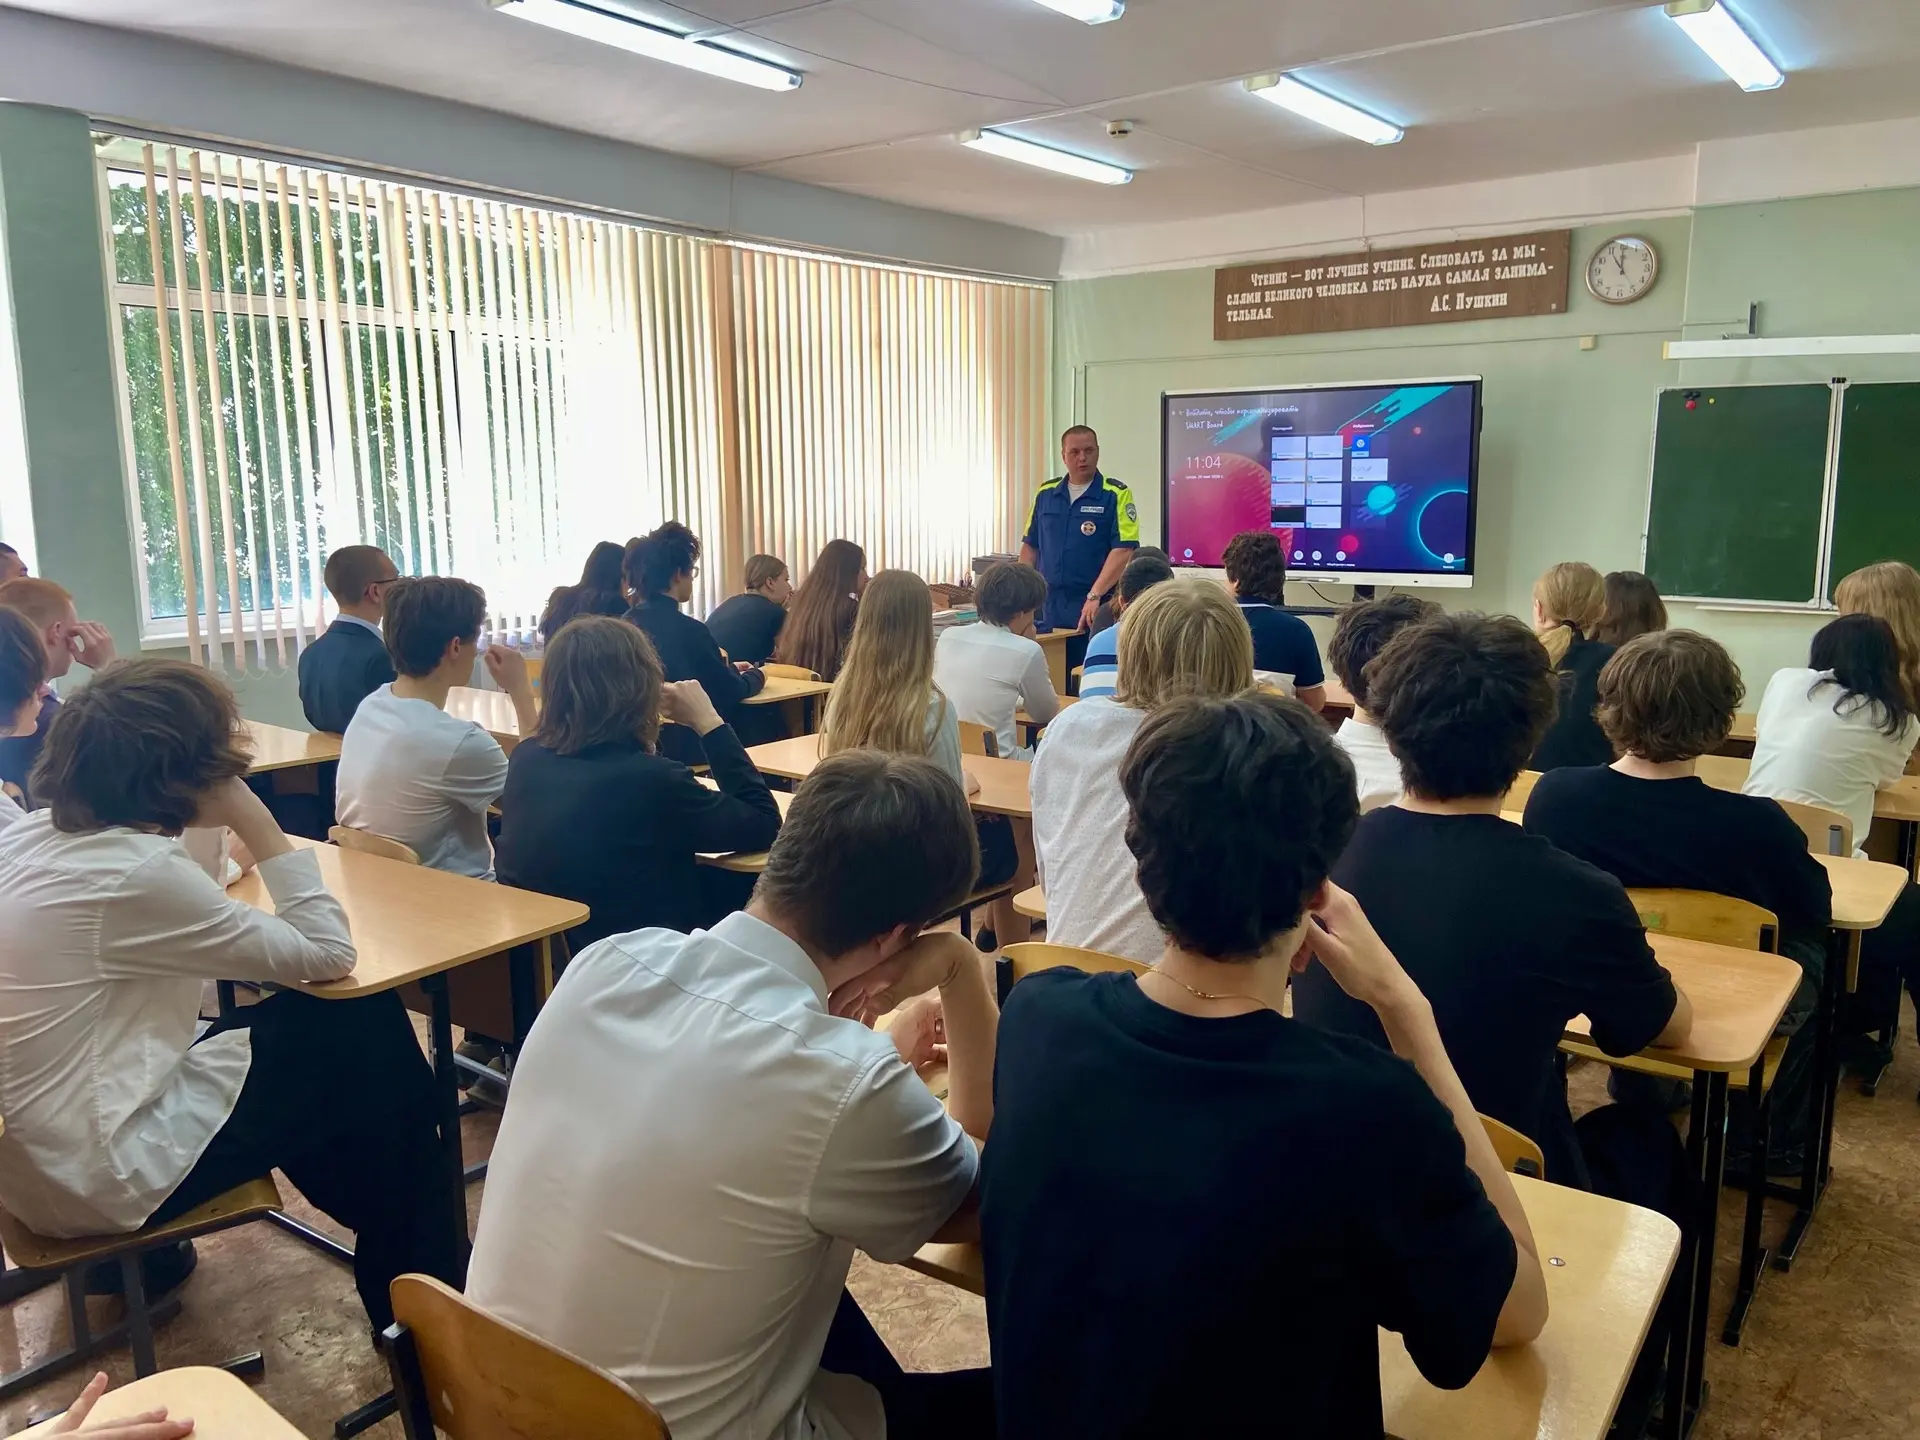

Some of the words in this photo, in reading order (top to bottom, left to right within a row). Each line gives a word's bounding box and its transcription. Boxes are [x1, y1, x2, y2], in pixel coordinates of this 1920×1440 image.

[1304, 268, 1323, 281] ВОТ
[1326, 263, 1368, 278] ЛУЧШЕЕ
[1492, 247, 1508, 261] ЗА
[1226, 291, 1261, 306] СЛЯМИ
[1264, 287, 1313, 303] ВЕЛИКОГО
[1316, 281, 1368, 298] ЧЕЛОВЕКА
[1372, 277, 1398, 292] ЕСТЬ
[1401, 273, 1442, 289] НАУКА
[1446, 268, 1490, 284] САМАЯ
[1226, 307, 1274, 322] ТЕЛЬНАЯ.
[1187, 456, 1222, 469] 11:04
